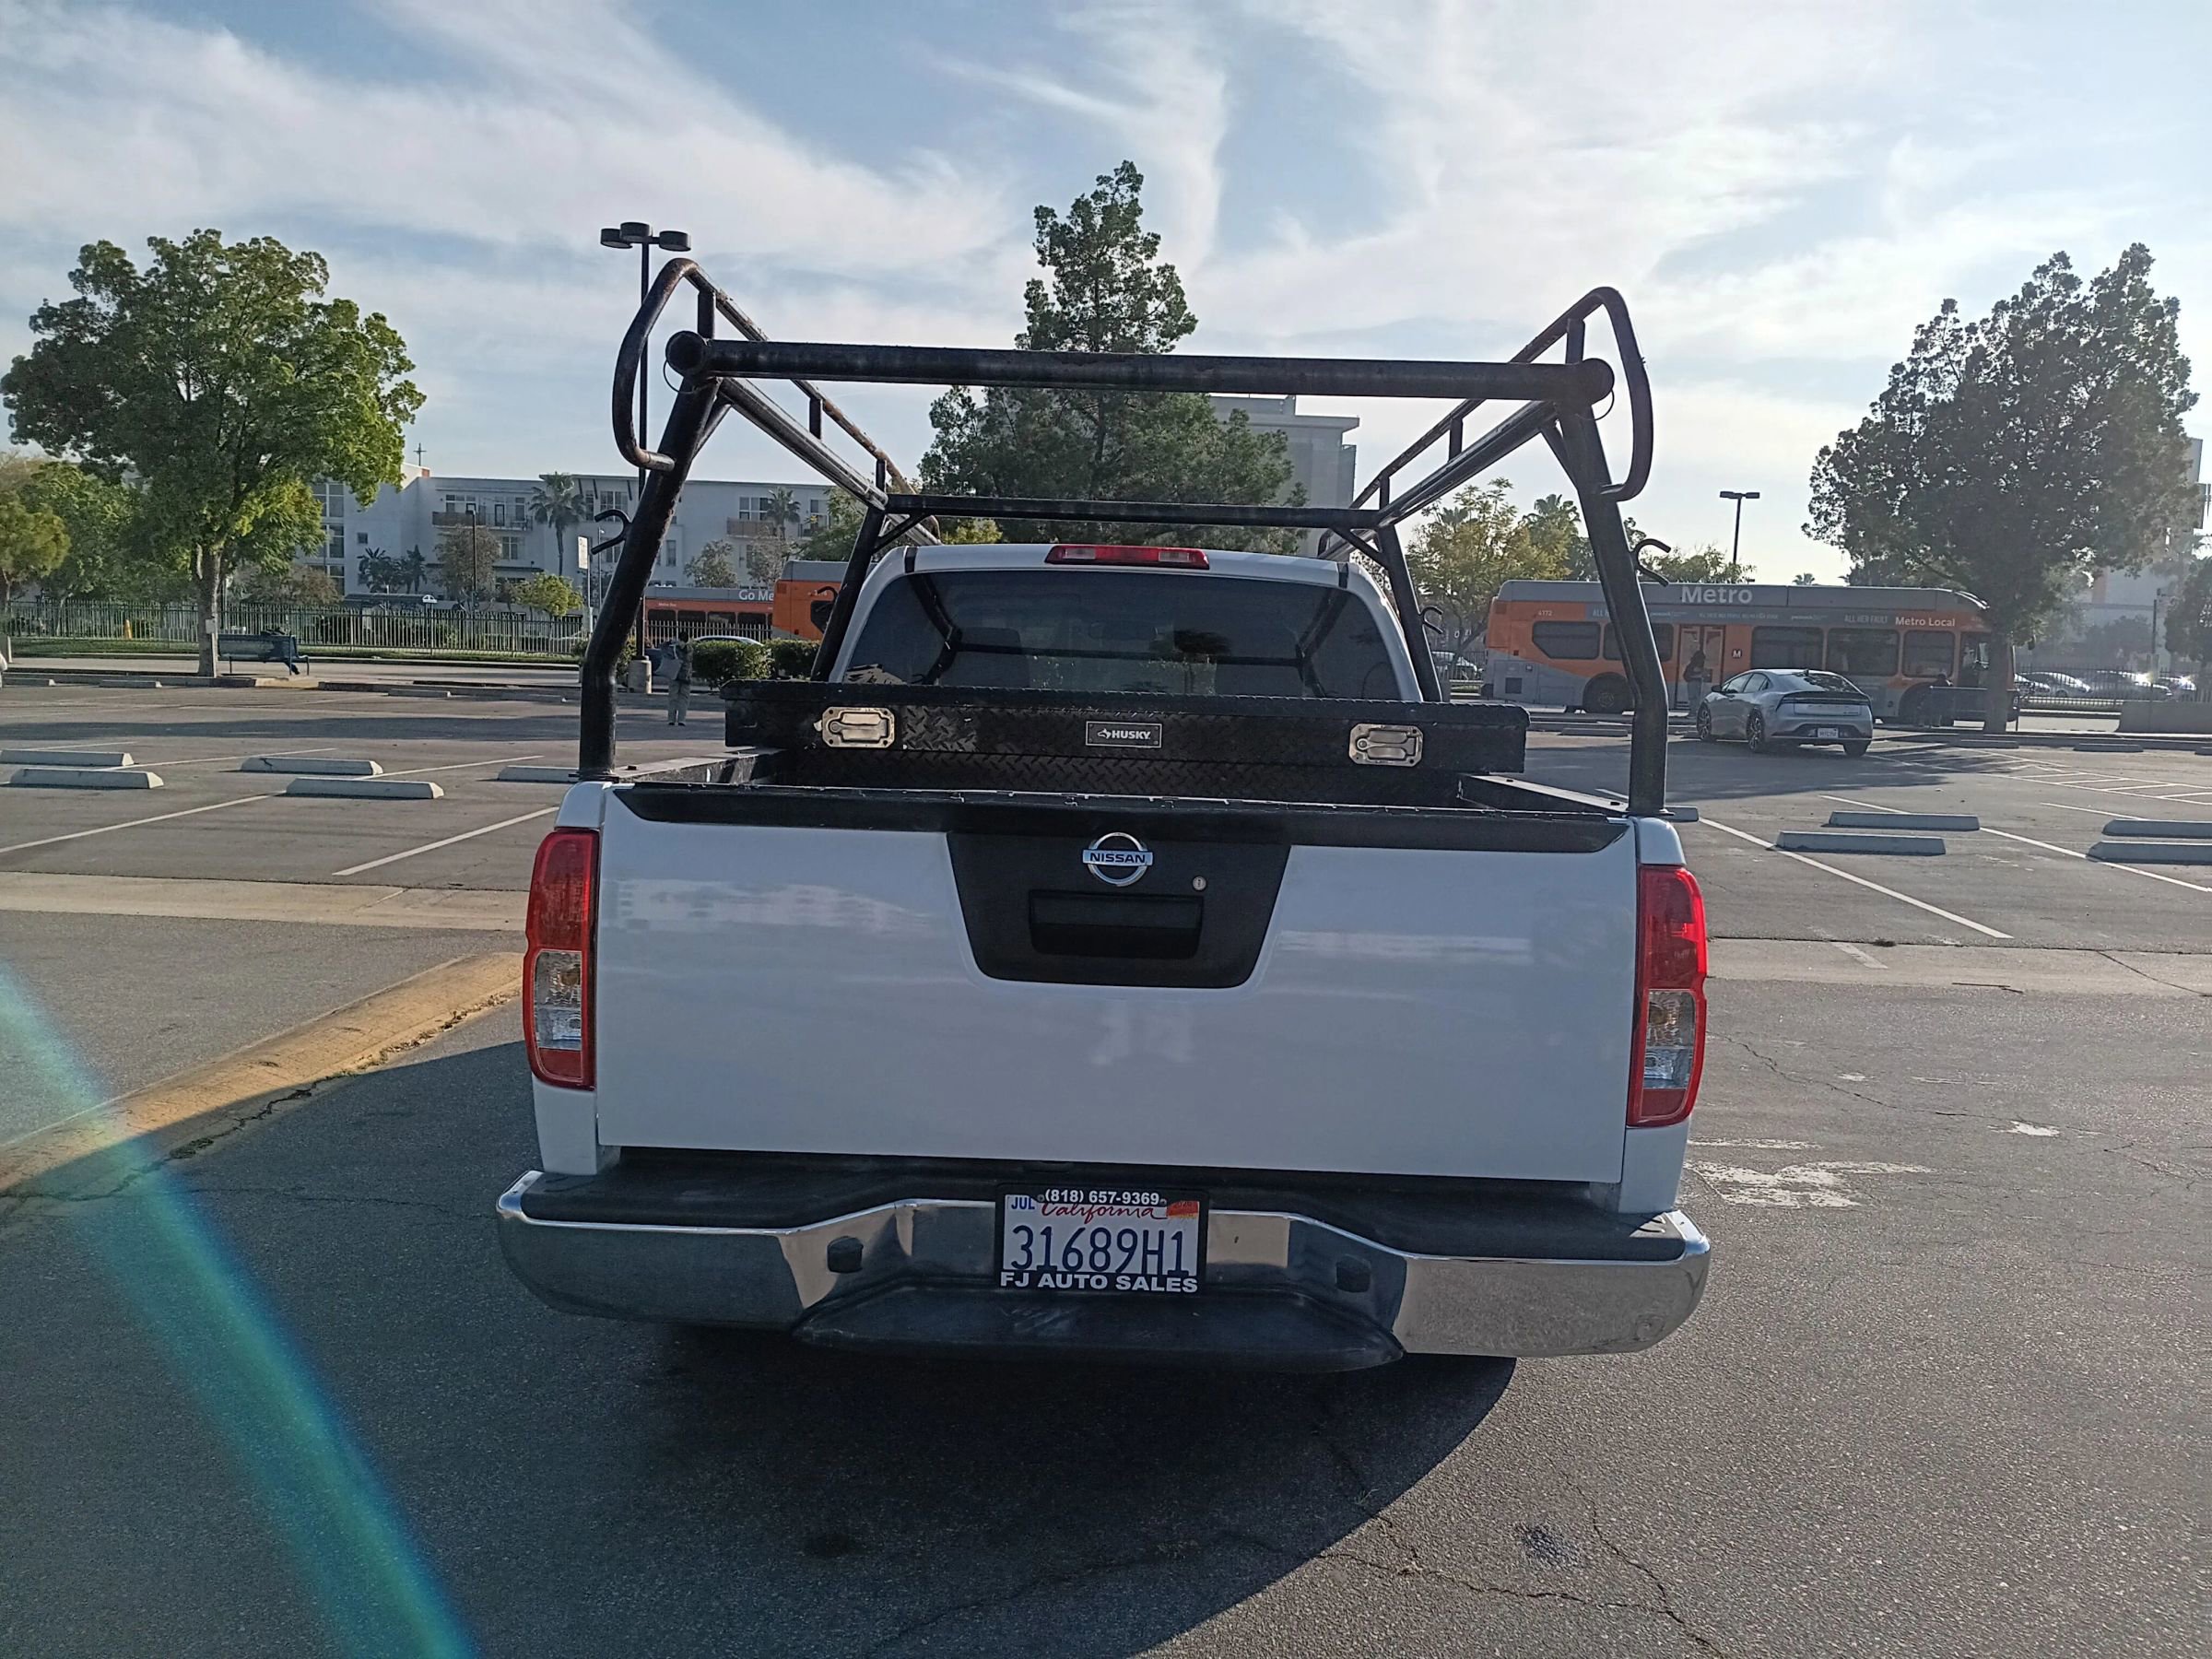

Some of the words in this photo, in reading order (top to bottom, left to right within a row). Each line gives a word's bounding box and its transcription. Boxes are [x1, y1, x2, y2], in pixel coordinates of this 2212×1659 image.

[738, 589, 755, 601] Go
[1681, 586, 1753, 604] Metro
[1844, 615, 1856, 623] ALL
[1871, 616, 1888, 624] FAULT
[1895, 617, 1925, 626] Metro
[1928, 618, 1955, 627] Local
[1112, 730, 1150, 740] HUSKY
[1089, 853, 1146, 864] NISSAN
[1011, 1197, 1036, 1210] JUL
[1045, 1189, 1084, 1203] (818)
[1088, 1190, 1159, 1206] 657-9369
[1041, 1203, 1168, 1224] California
[1010, 1225, 1189, 1276] 31689H1
[1000, 1272, 1030, 1288] FJ
[1038, 1273, 1108, 1289] AUTO
[1115, 1277, 1197, 1293] SALES
